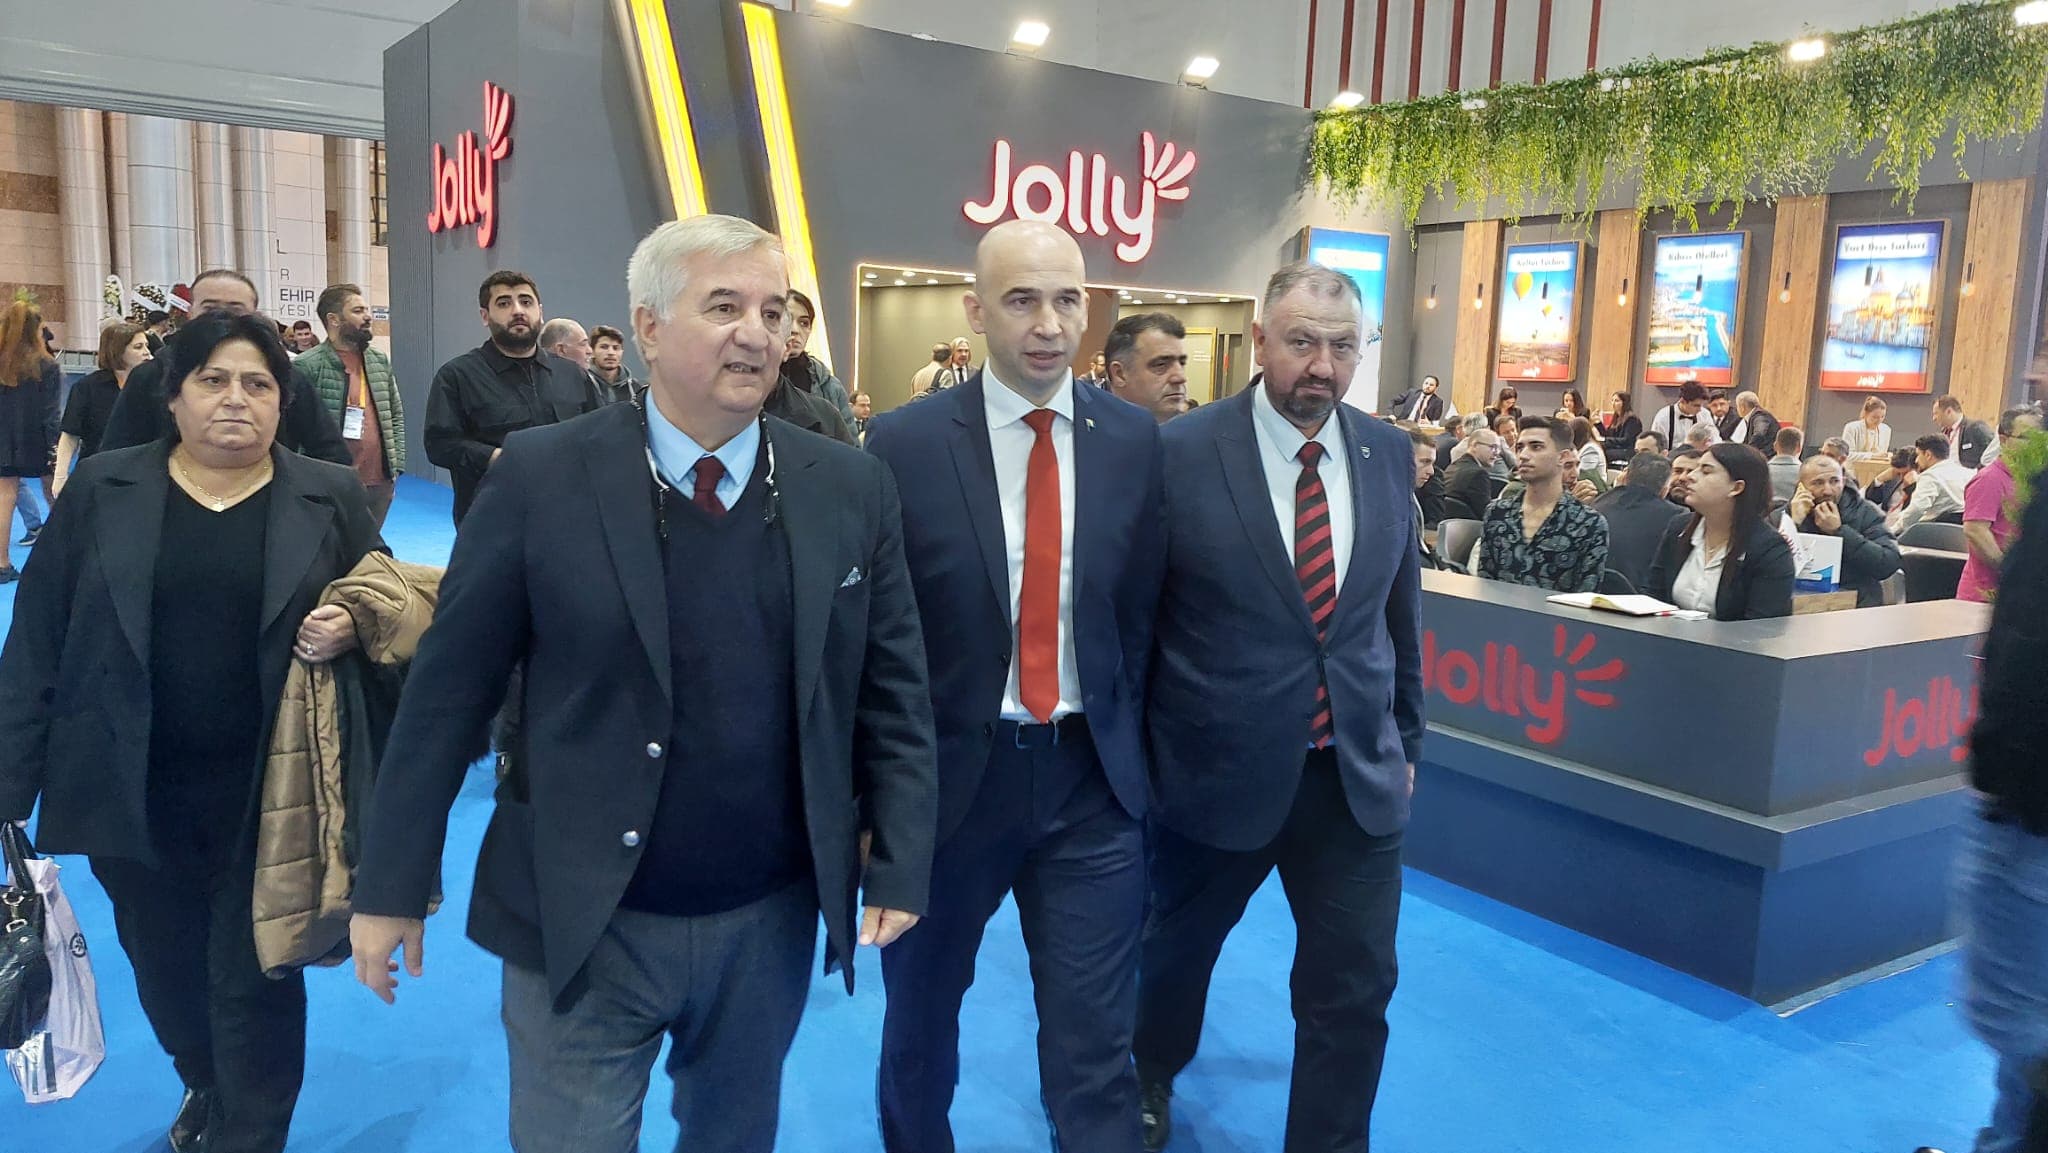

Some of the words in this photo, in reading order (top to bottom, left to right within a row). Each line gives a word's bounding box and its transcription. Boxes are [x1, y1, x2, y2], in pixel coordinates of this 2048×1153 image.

[428, 129, 497, 249] Jolly
[962, 138, 1158, 263] Jolly
[1863, 673, 1981, 767] Jolly
